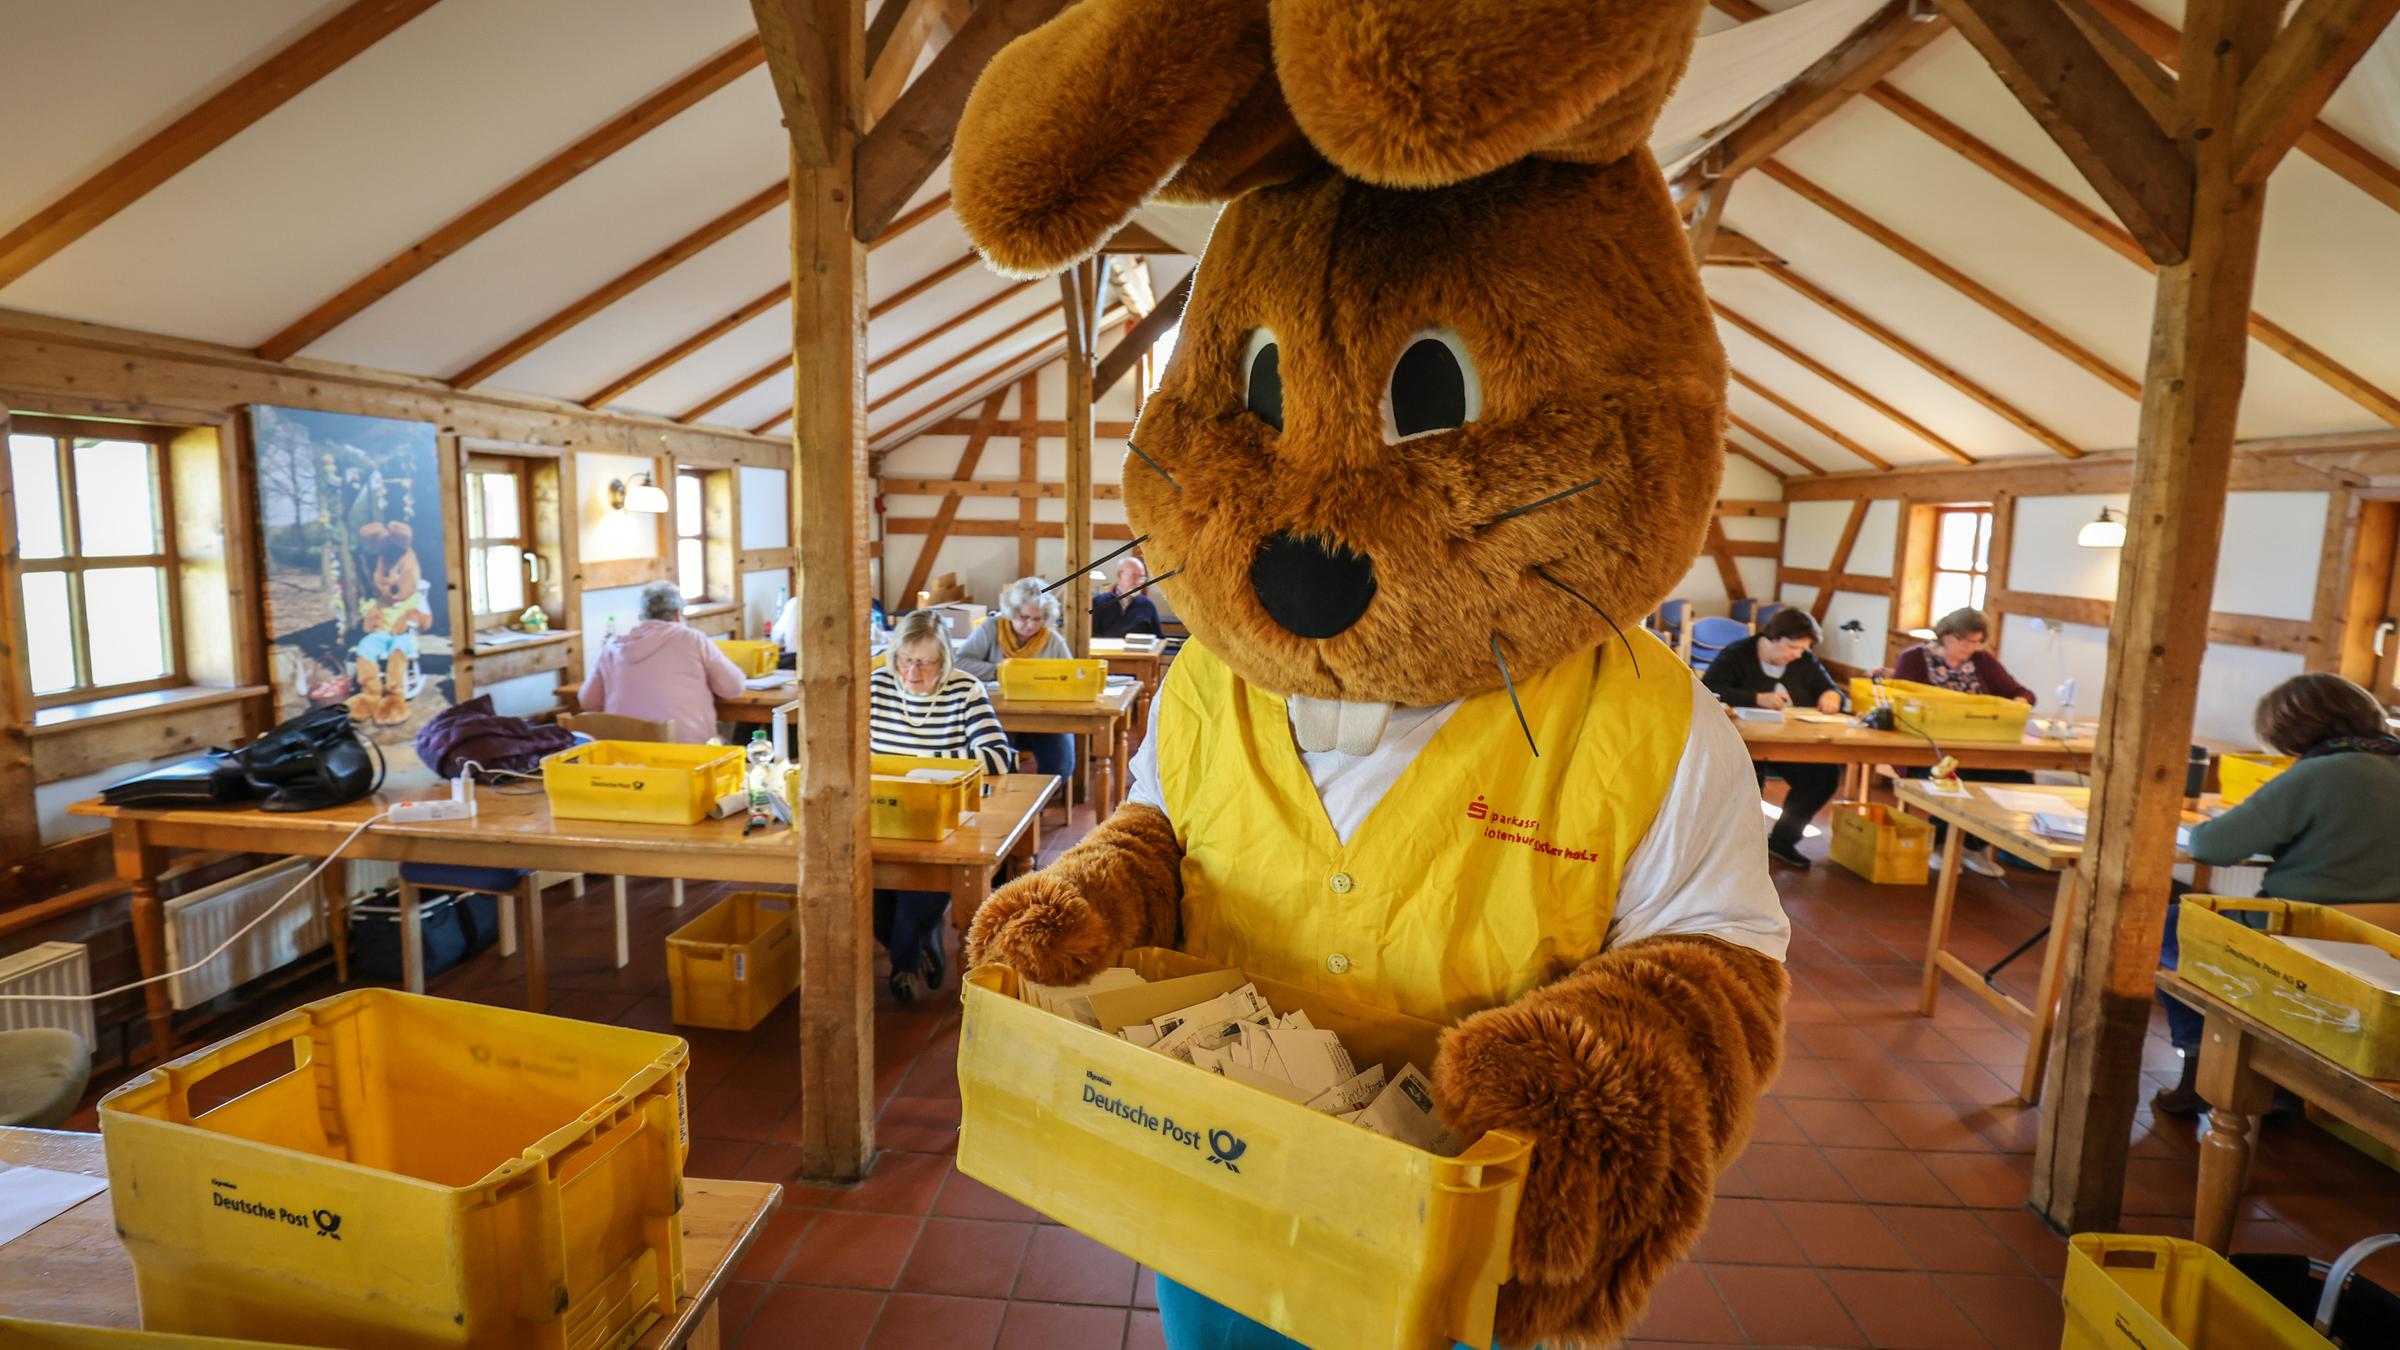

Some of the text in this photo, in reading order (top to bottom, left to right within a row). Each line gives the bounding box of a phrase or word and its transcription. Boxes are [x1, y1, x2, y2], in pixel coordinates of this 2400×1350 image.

[1082, 1084, 1201, 1150] Deutsche Post
[213, 1192, 309, 1228] Deutsche Post
